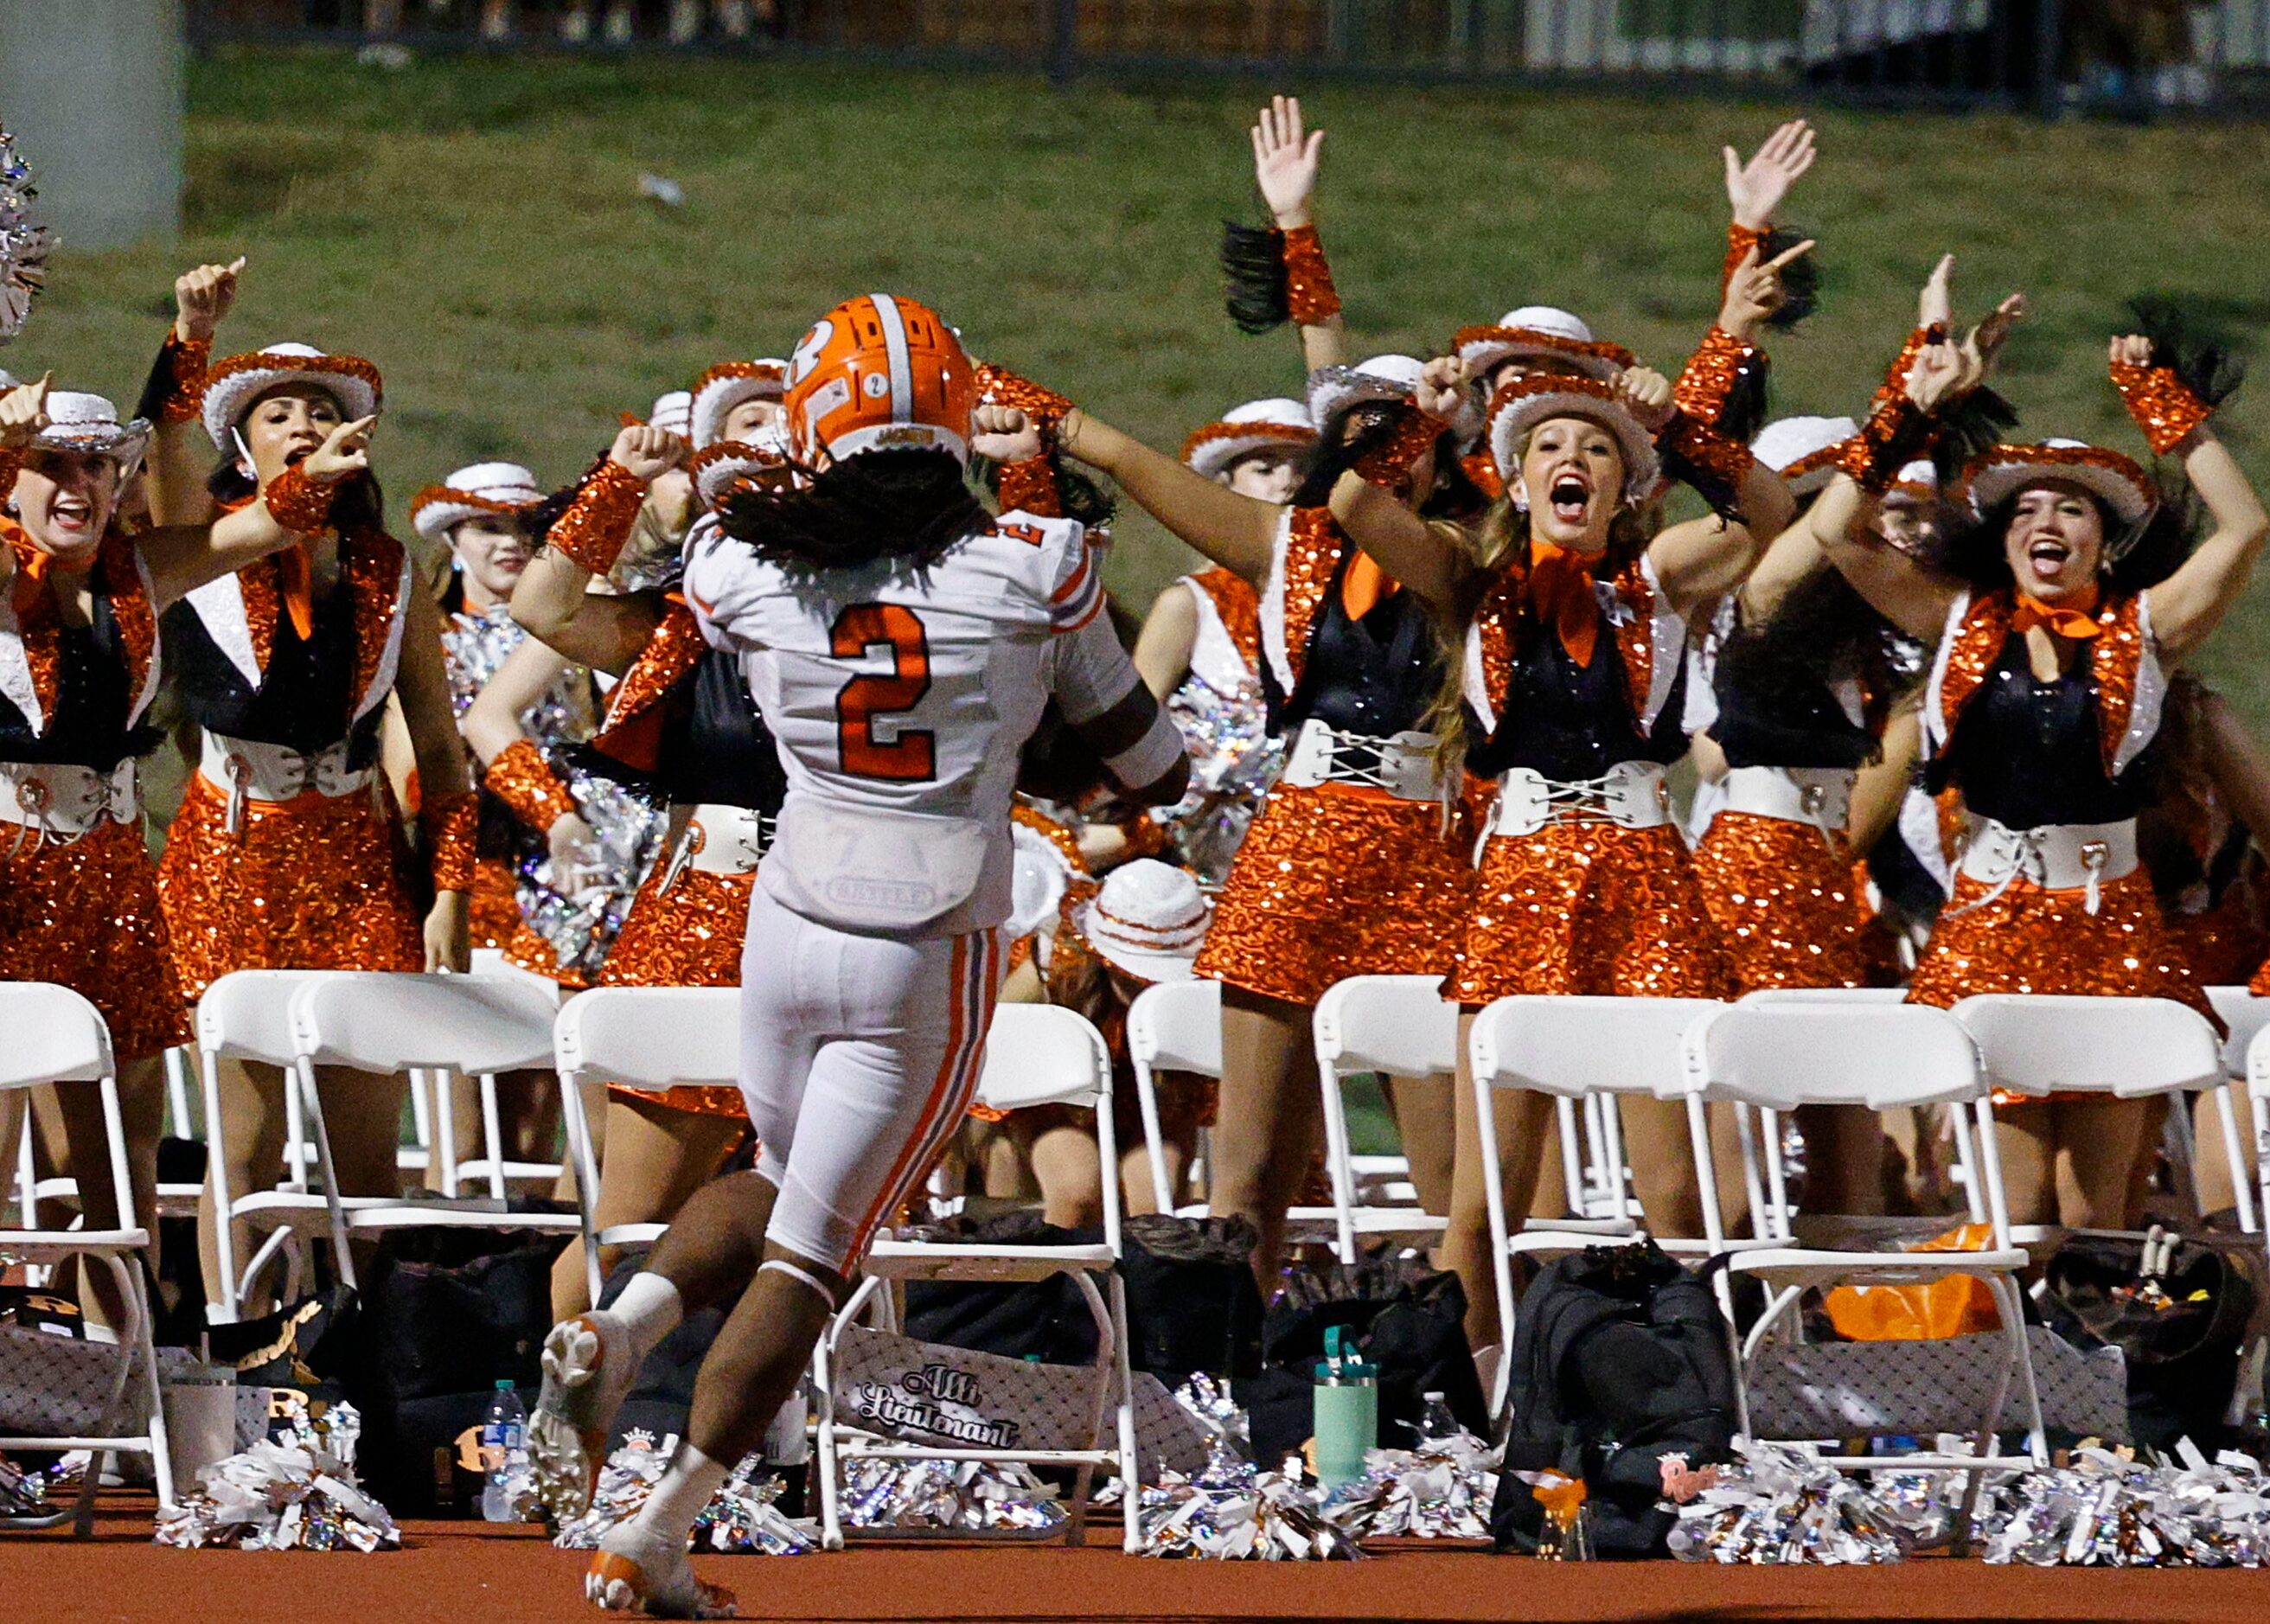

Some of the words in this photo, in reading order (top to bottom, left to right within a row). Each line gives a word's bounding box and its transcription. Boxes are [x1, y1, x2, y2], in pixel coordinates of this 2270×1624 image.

[870, 375, 880, 395] 2
[829, 602, 937, 782] 2
[901, 1362, 982, 1408] Alli
[859, 1381, 1019, 1448] Lieutenant
